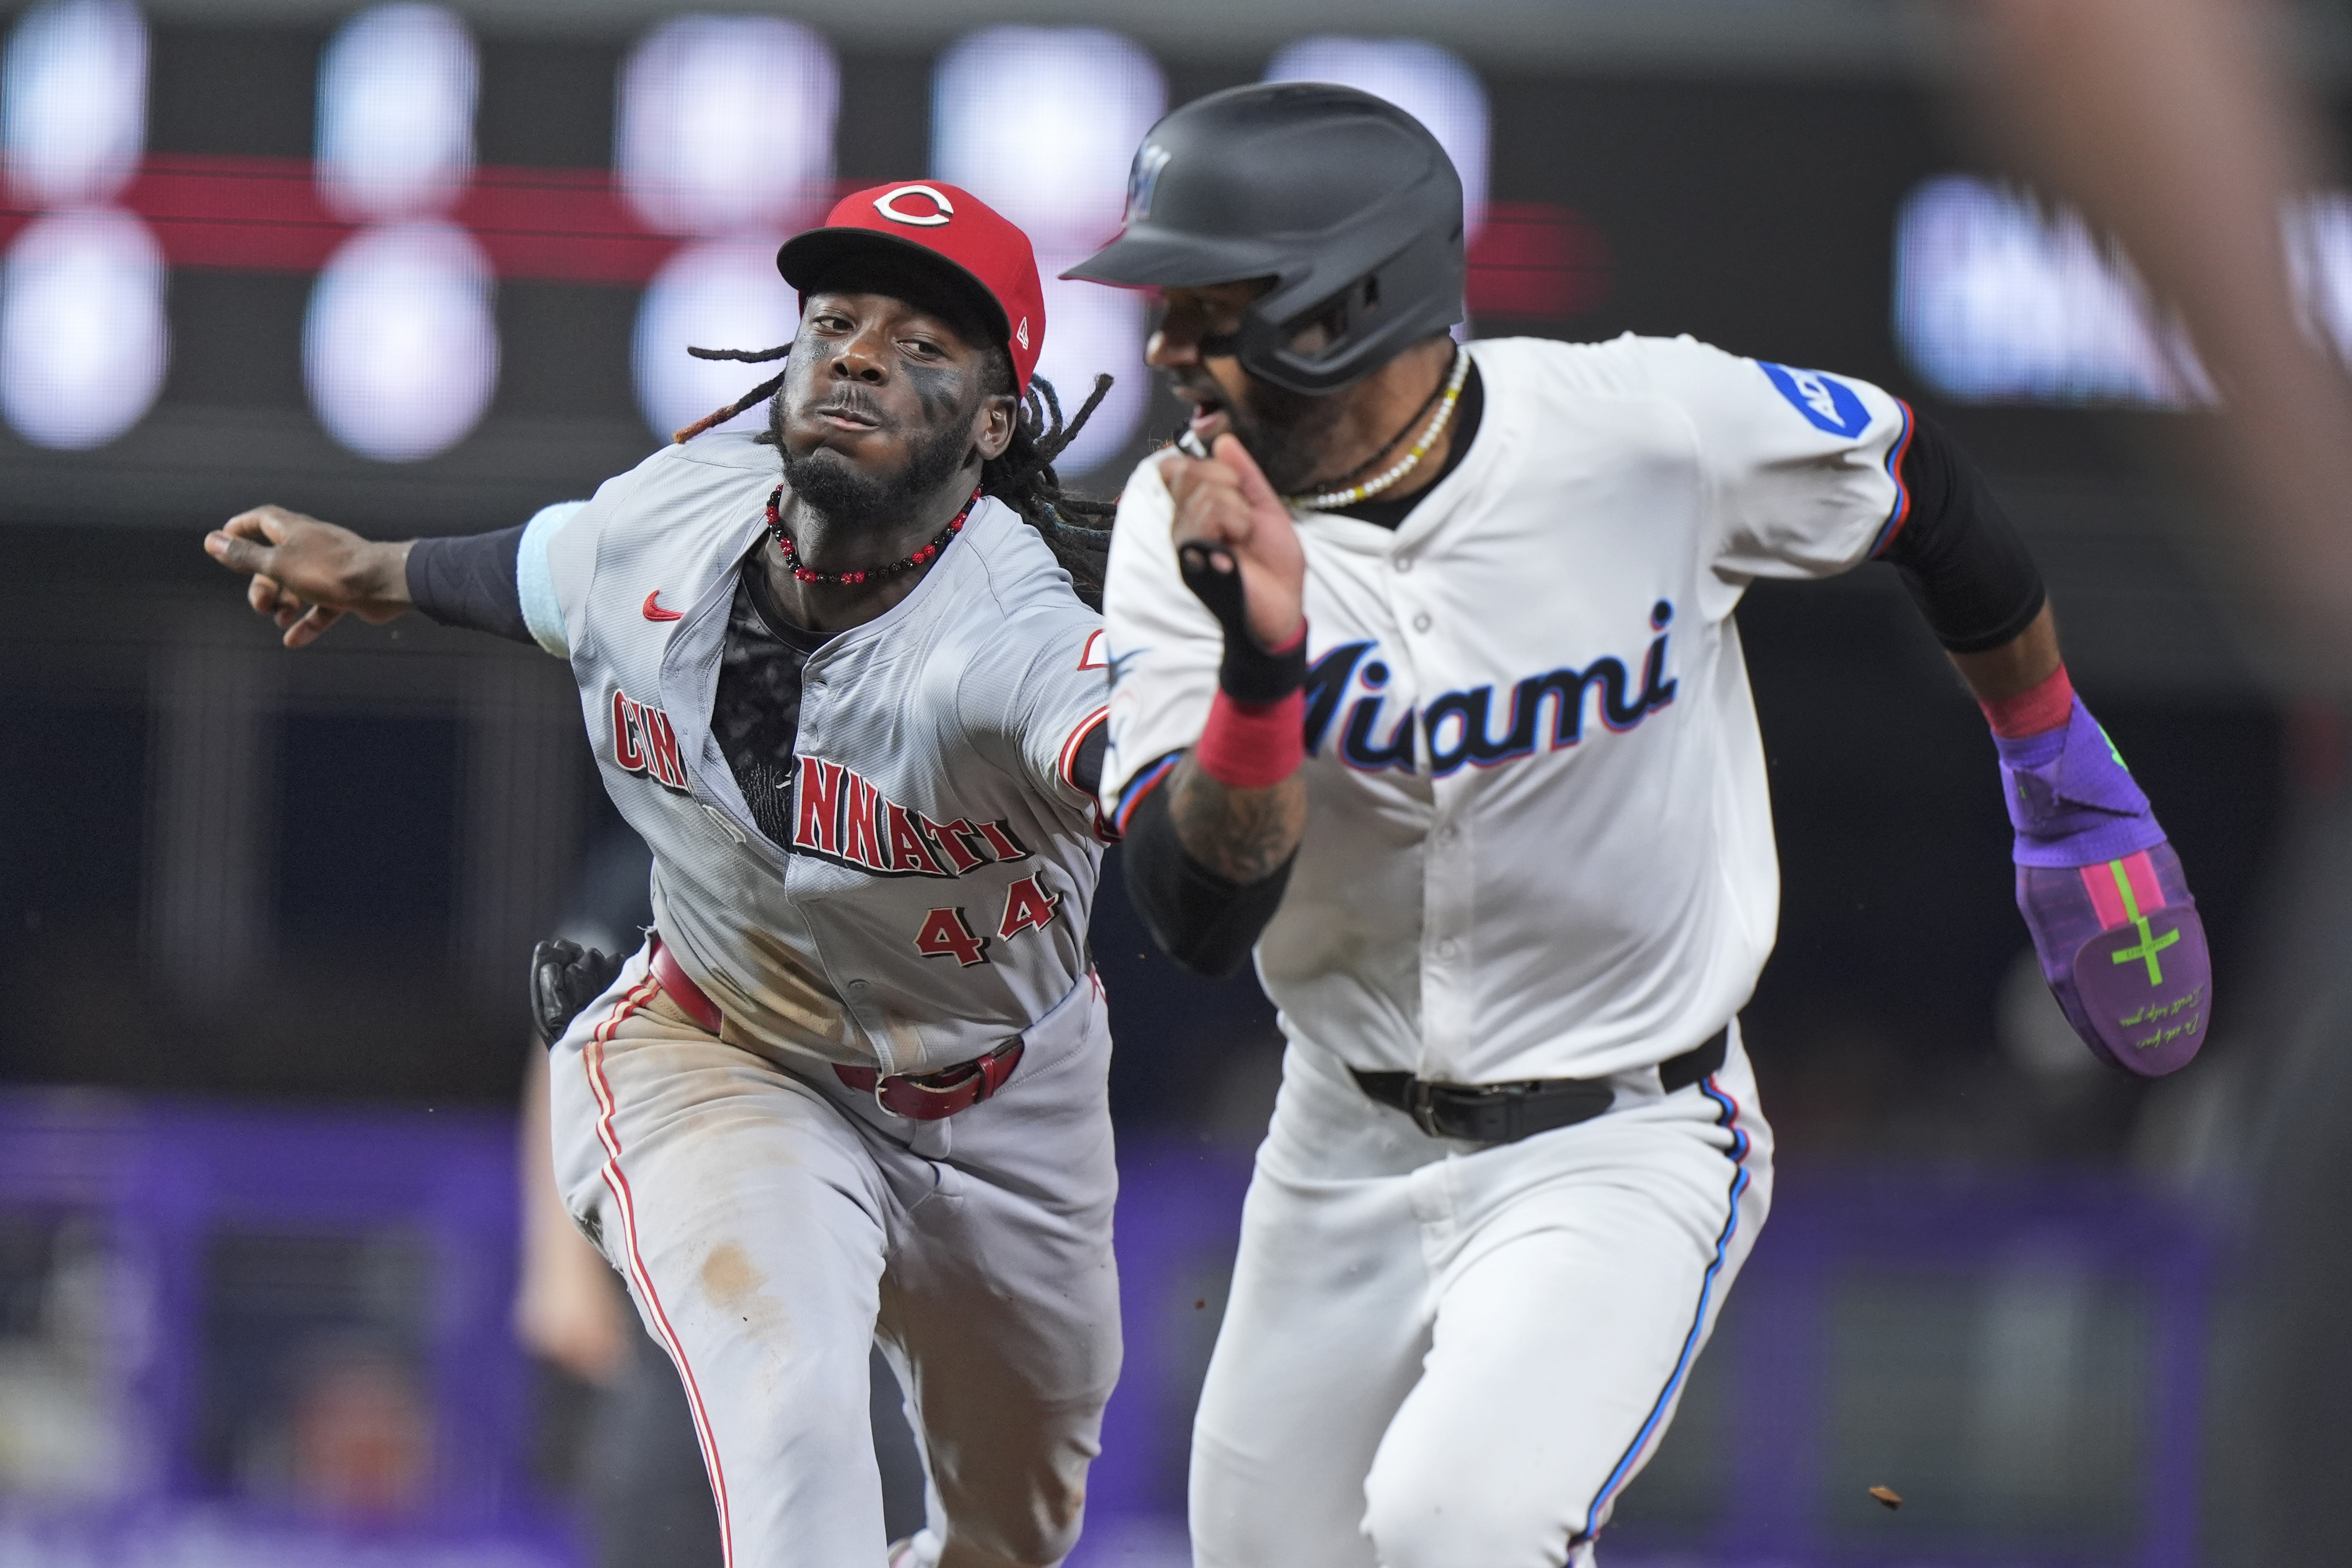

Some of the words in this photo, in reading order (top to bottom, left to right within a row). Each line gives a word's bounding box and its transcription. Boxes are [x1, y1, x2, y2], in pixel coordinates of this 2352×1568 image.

[873, 184, 954, 228] C
[1778, 363, 1847, 429] AD
[612, 688, 1034, 879] CINNNATI
